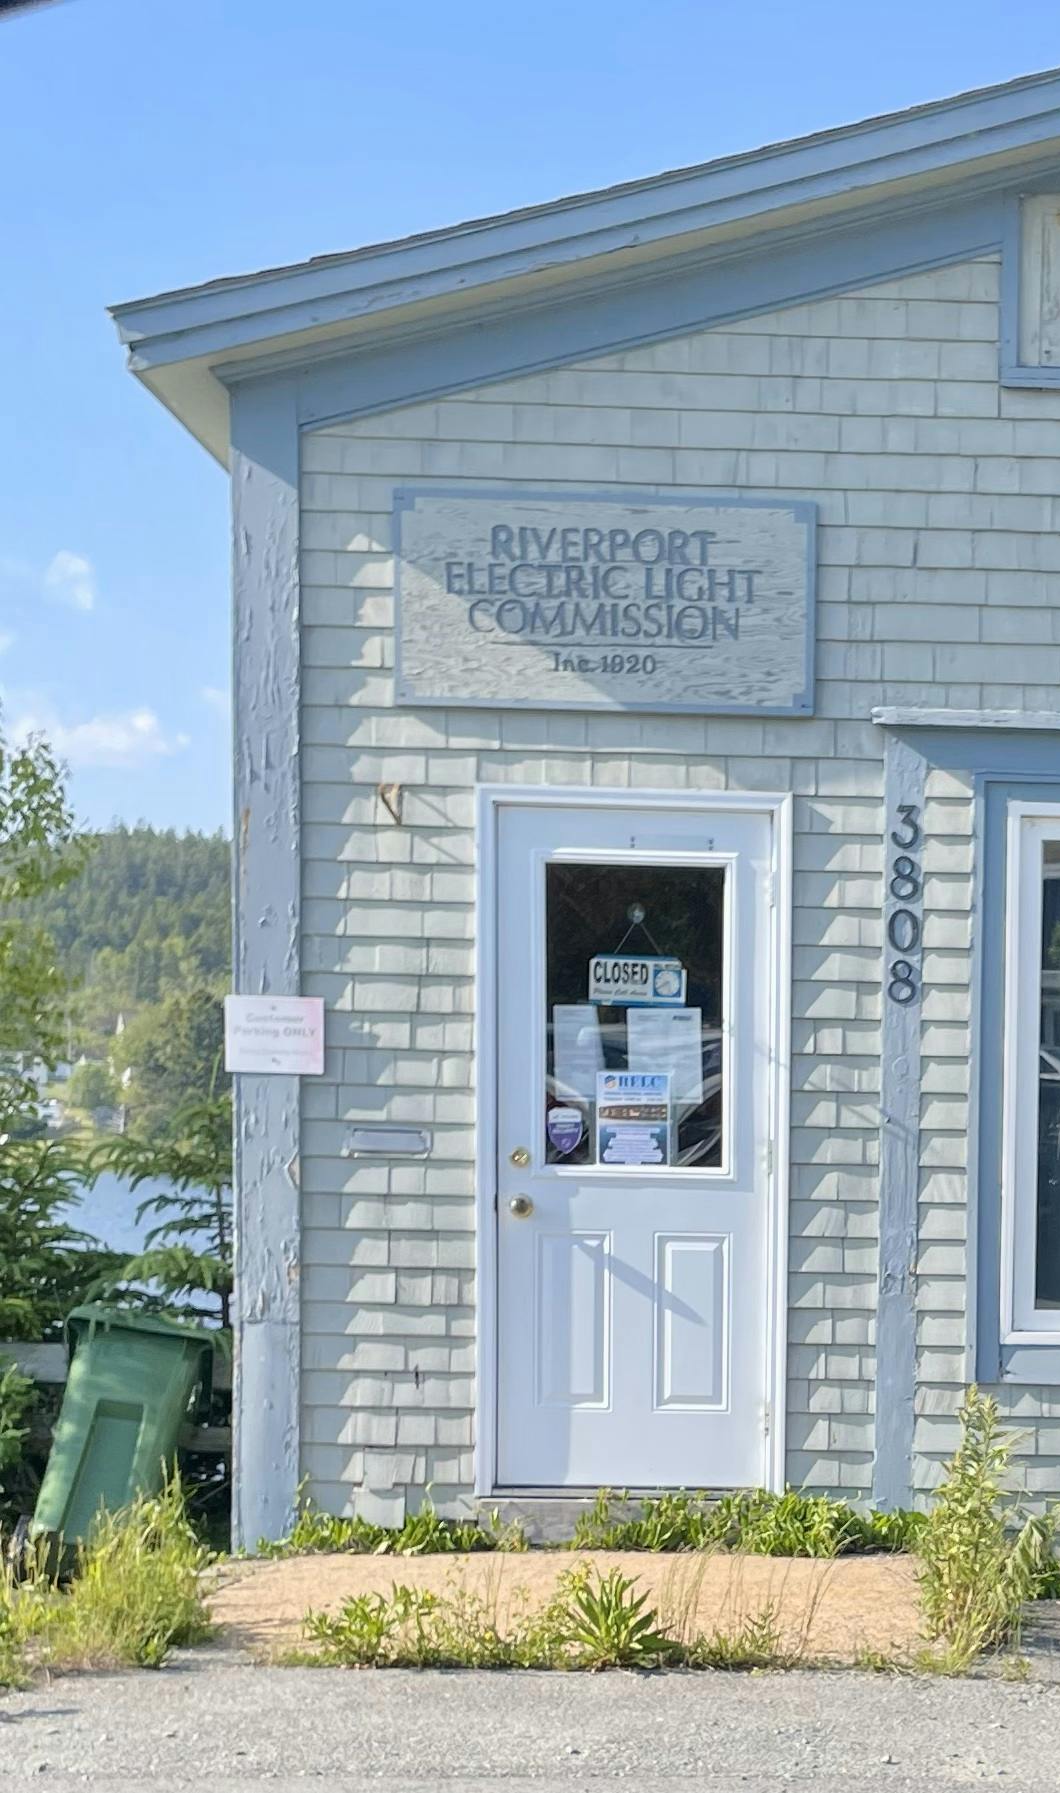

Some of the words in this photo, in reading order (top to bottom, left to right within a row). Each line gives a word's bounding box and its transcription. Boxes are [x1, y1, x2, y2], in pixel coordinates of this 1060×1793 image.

[490, 524, 717, 566] RIVERPORT
[445, 561, 631, 600] ELECTRIC
[643, 567, 763, 605] LIGHT
[468, 598, 740, 641] COMMISSION
[600, 654, 657, 675] 1920
[888, 804, 919, 1005] 3808
[593, 960, 649, 985] CLOSED
[283, 1027, 318, 1038] ONLY
